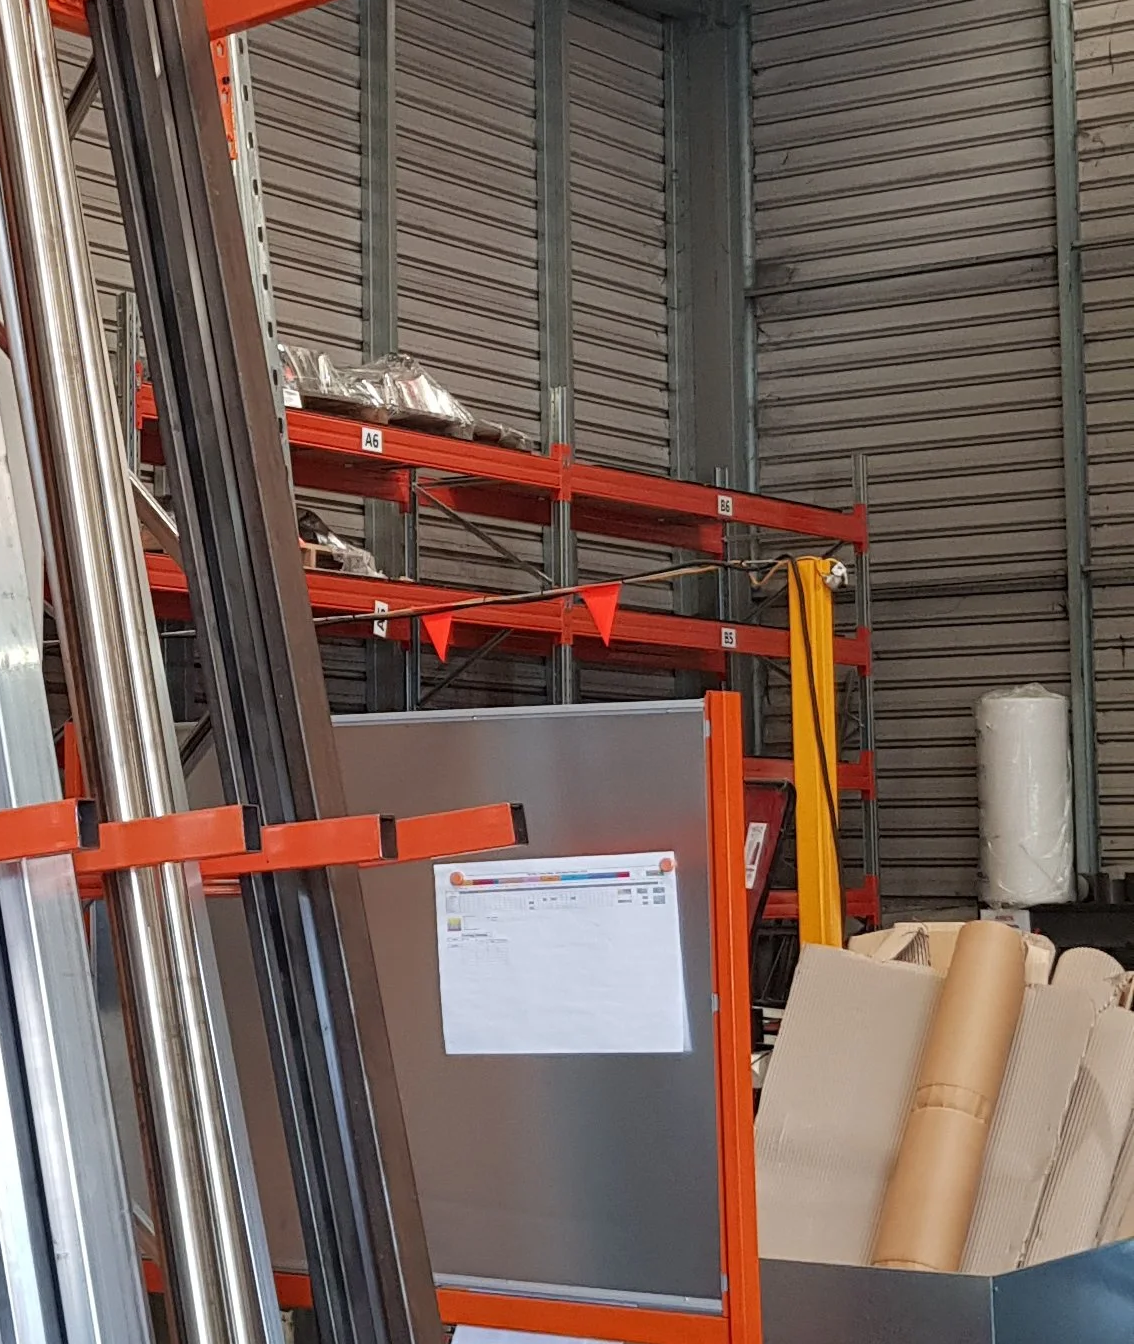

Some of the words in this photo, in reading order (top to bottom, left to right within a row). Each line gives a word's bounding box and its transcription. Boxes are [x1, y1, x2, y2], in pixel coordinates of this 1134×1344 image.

[365, 433, 379, 448] A6
[720, 499, 730, 513] B6
[724, 631, 734, 645] B5
